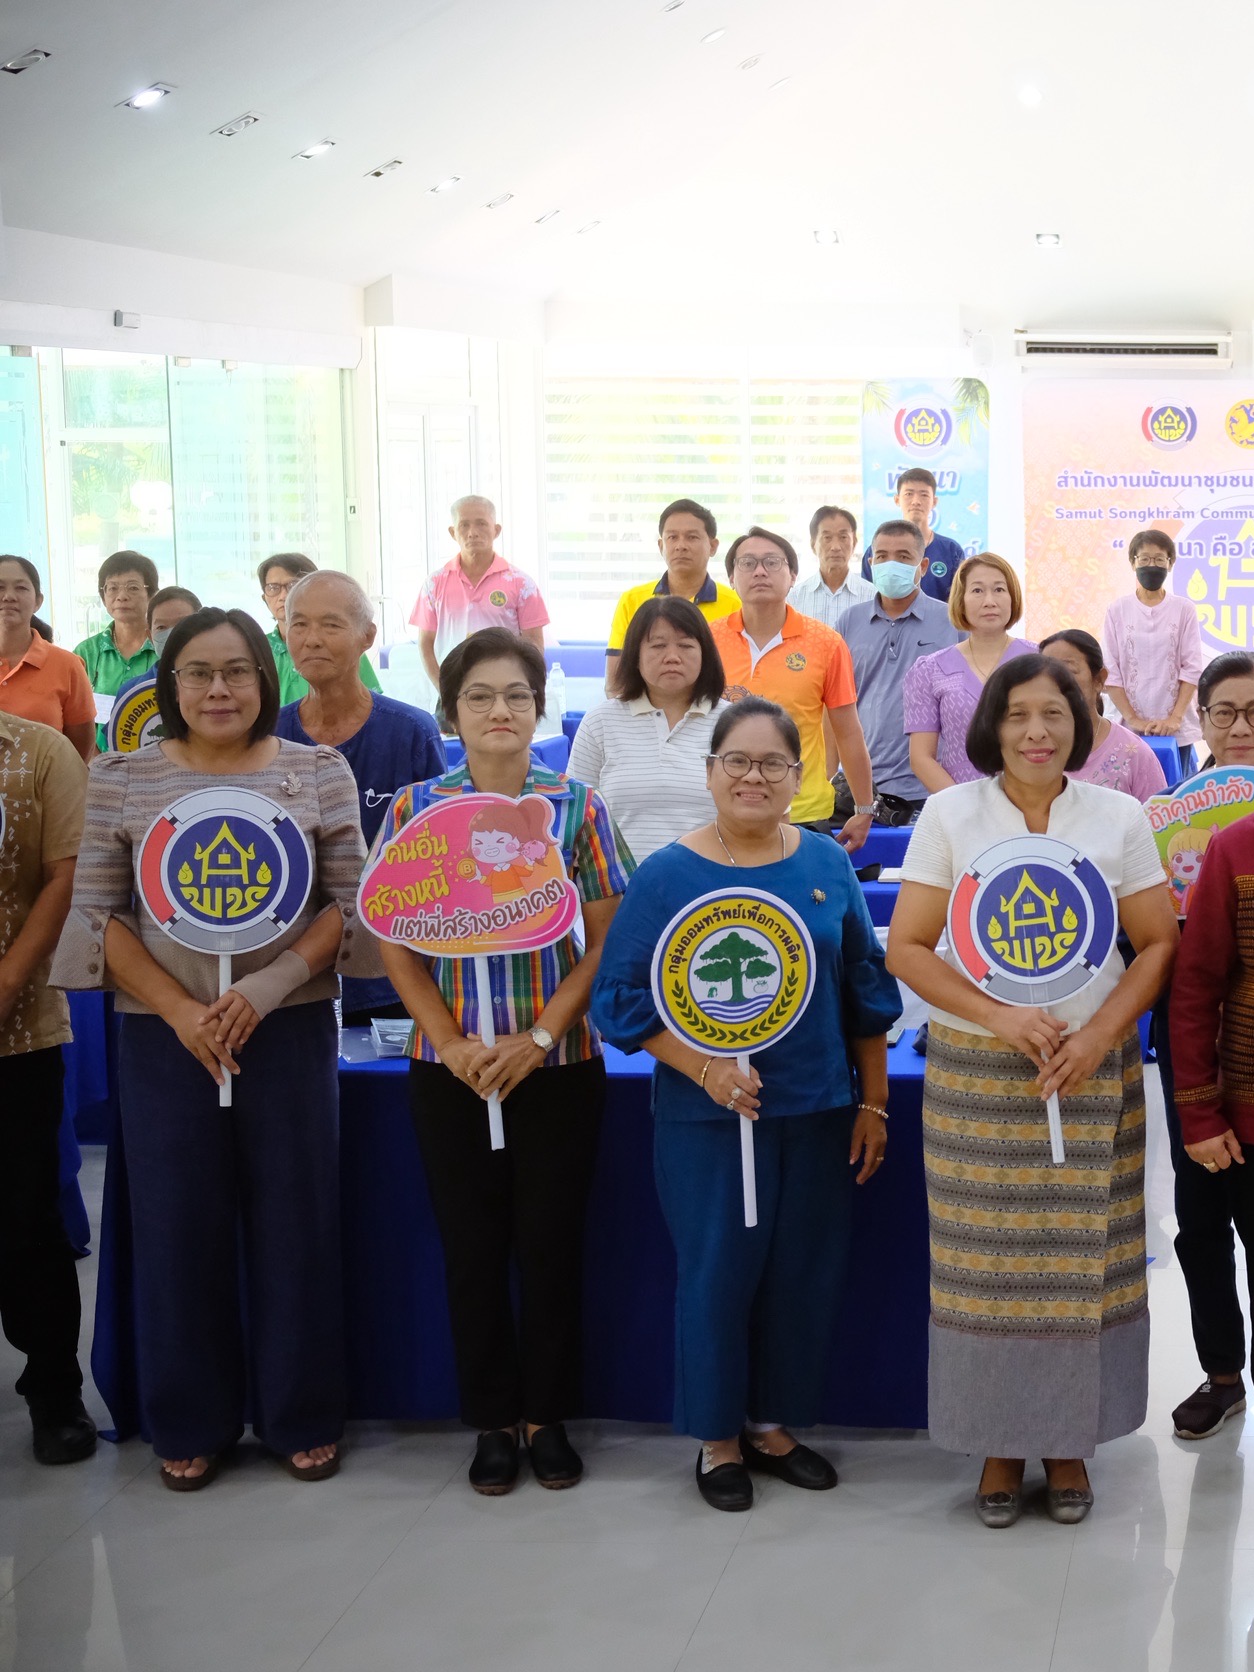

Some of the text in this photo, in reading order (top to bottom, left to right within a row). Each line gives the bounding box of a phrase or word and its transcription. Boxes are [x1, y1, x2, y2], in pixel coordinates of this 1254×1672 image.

[1056, 507, 1103, 519] Samut
[1109, 507, 1195, 522] Songkhram
[1212, 536, 1243, 557] คือ
[1149, 776, 1253, 831] ถ้าคุณกำลัง
[384, 821, 448, 865] คนอื่น
[364, 858, 450, 921] สร้างหนี้
[392, 879, 566, 939] แต่พี่สร้างอนาคต
[668, 903, 800, 974] กลุ่มออมทรัพย์เพื่อการผลิต
